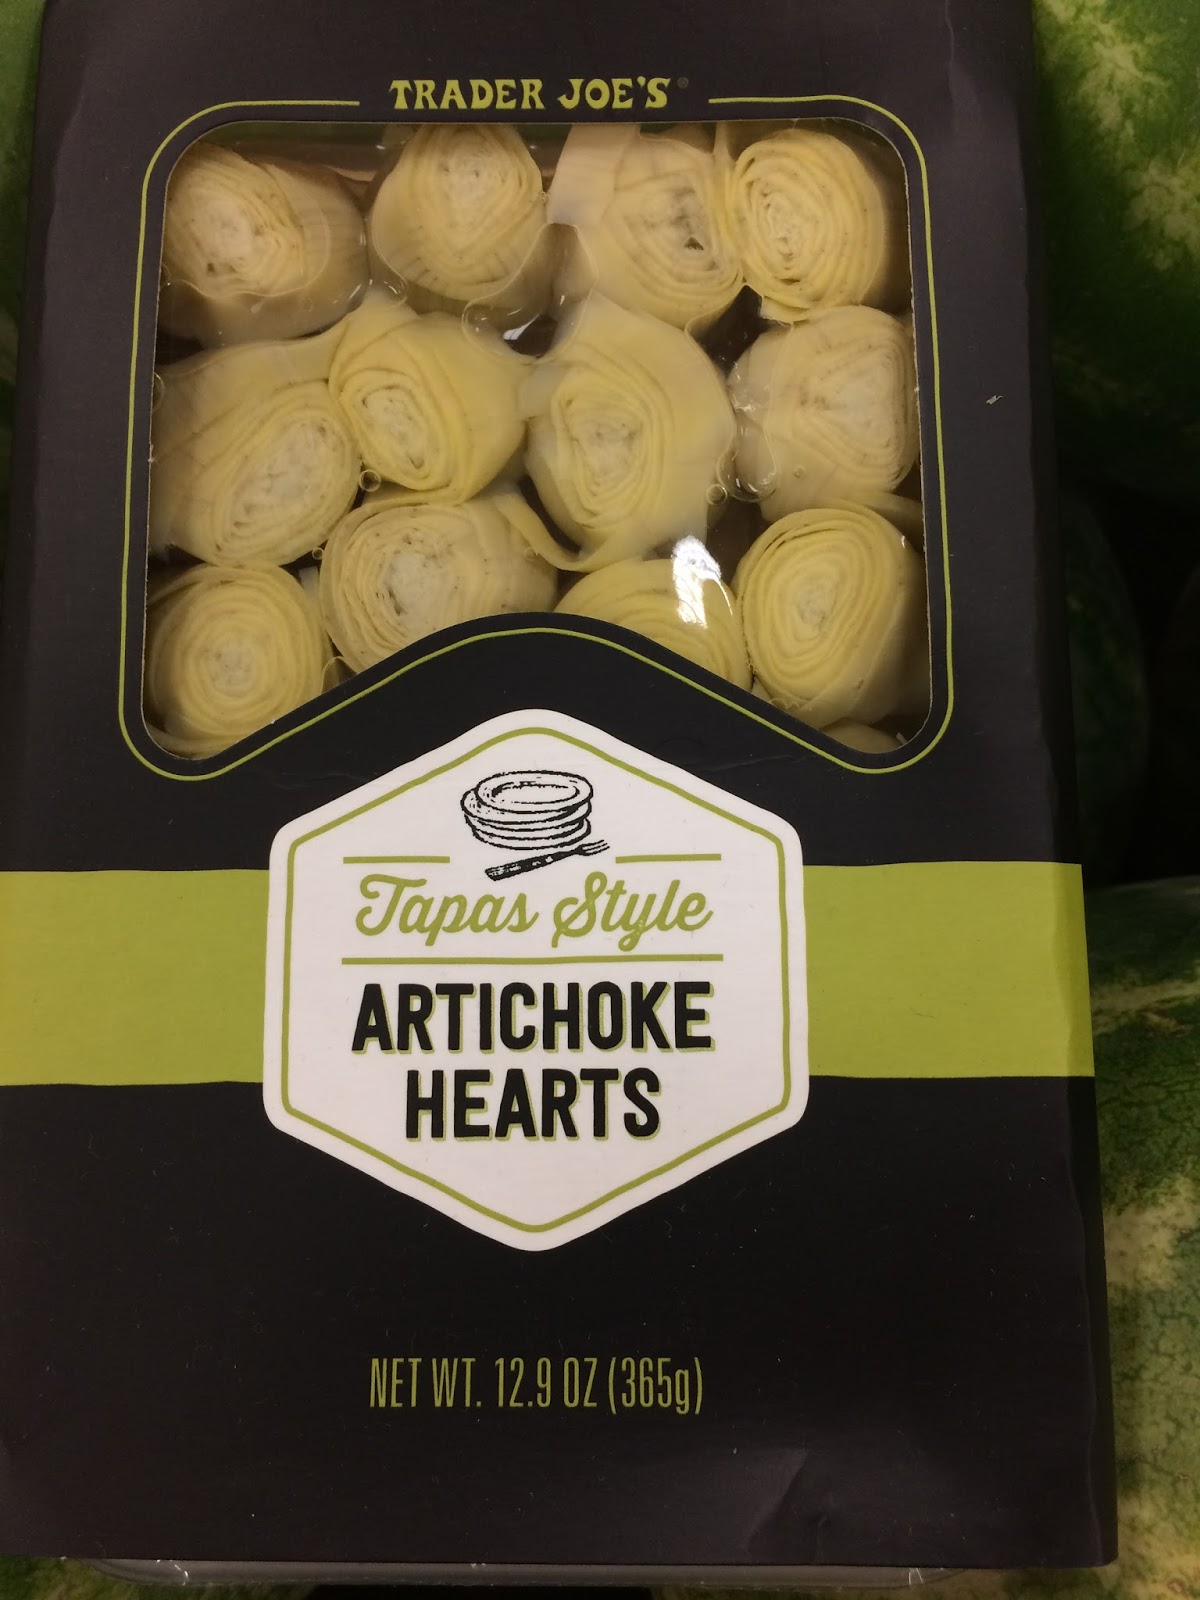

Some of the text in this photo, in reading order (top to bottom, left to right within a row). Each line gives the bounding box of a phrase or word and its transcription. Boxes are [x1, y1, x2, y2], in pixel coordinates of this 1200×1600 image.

[388, 75, 672, 110] TRADER JOE'S
[355, 871, 714, 952] Tapas Style
[351, 980, 716, 1054] ARTICHOKE
[404, 1067, 662, 1142] HEARTS
[369, 1356, 704, 1415] NET WT. 12.9 OZ (365g)
